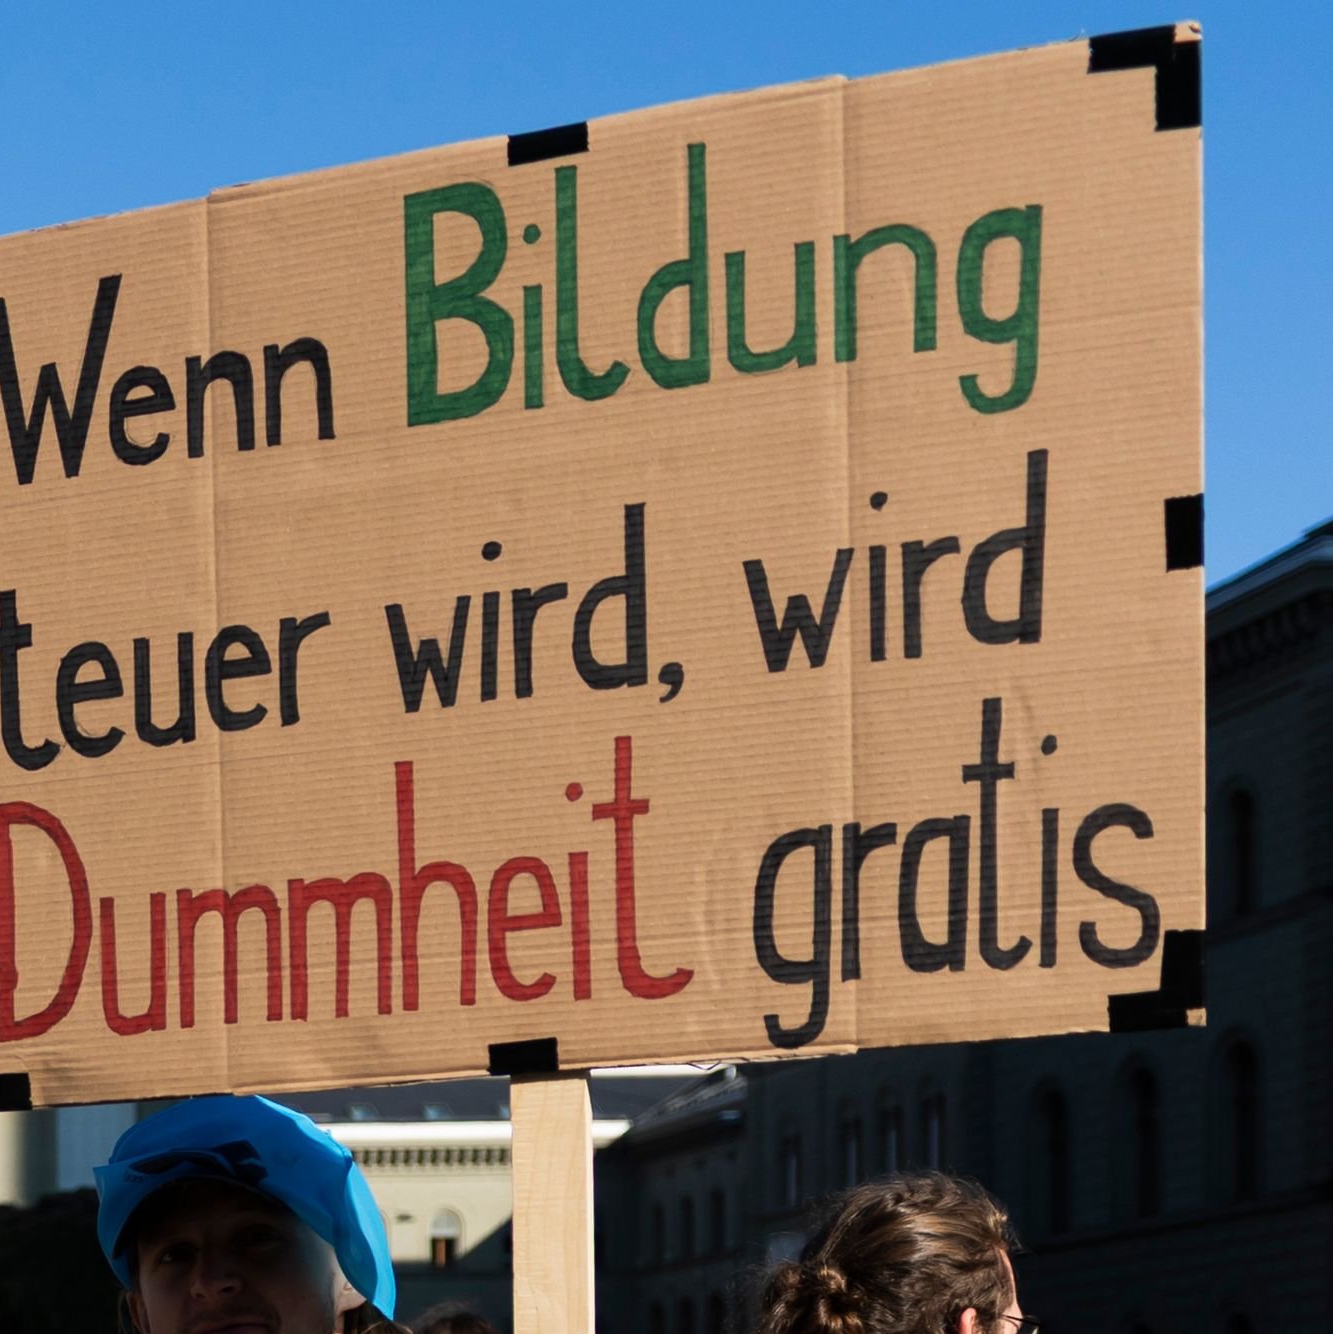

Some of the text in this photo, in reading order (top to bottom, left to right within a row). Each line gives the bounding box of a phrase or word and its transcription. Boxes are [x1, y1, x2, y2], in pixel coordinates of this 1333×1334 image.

[404, 142, 1043, 427] Bildung
[385, 502, 685, 713] wird,
[743, 448, 1049, 673] wird
[753, 698, 1161, 1049] gratis
